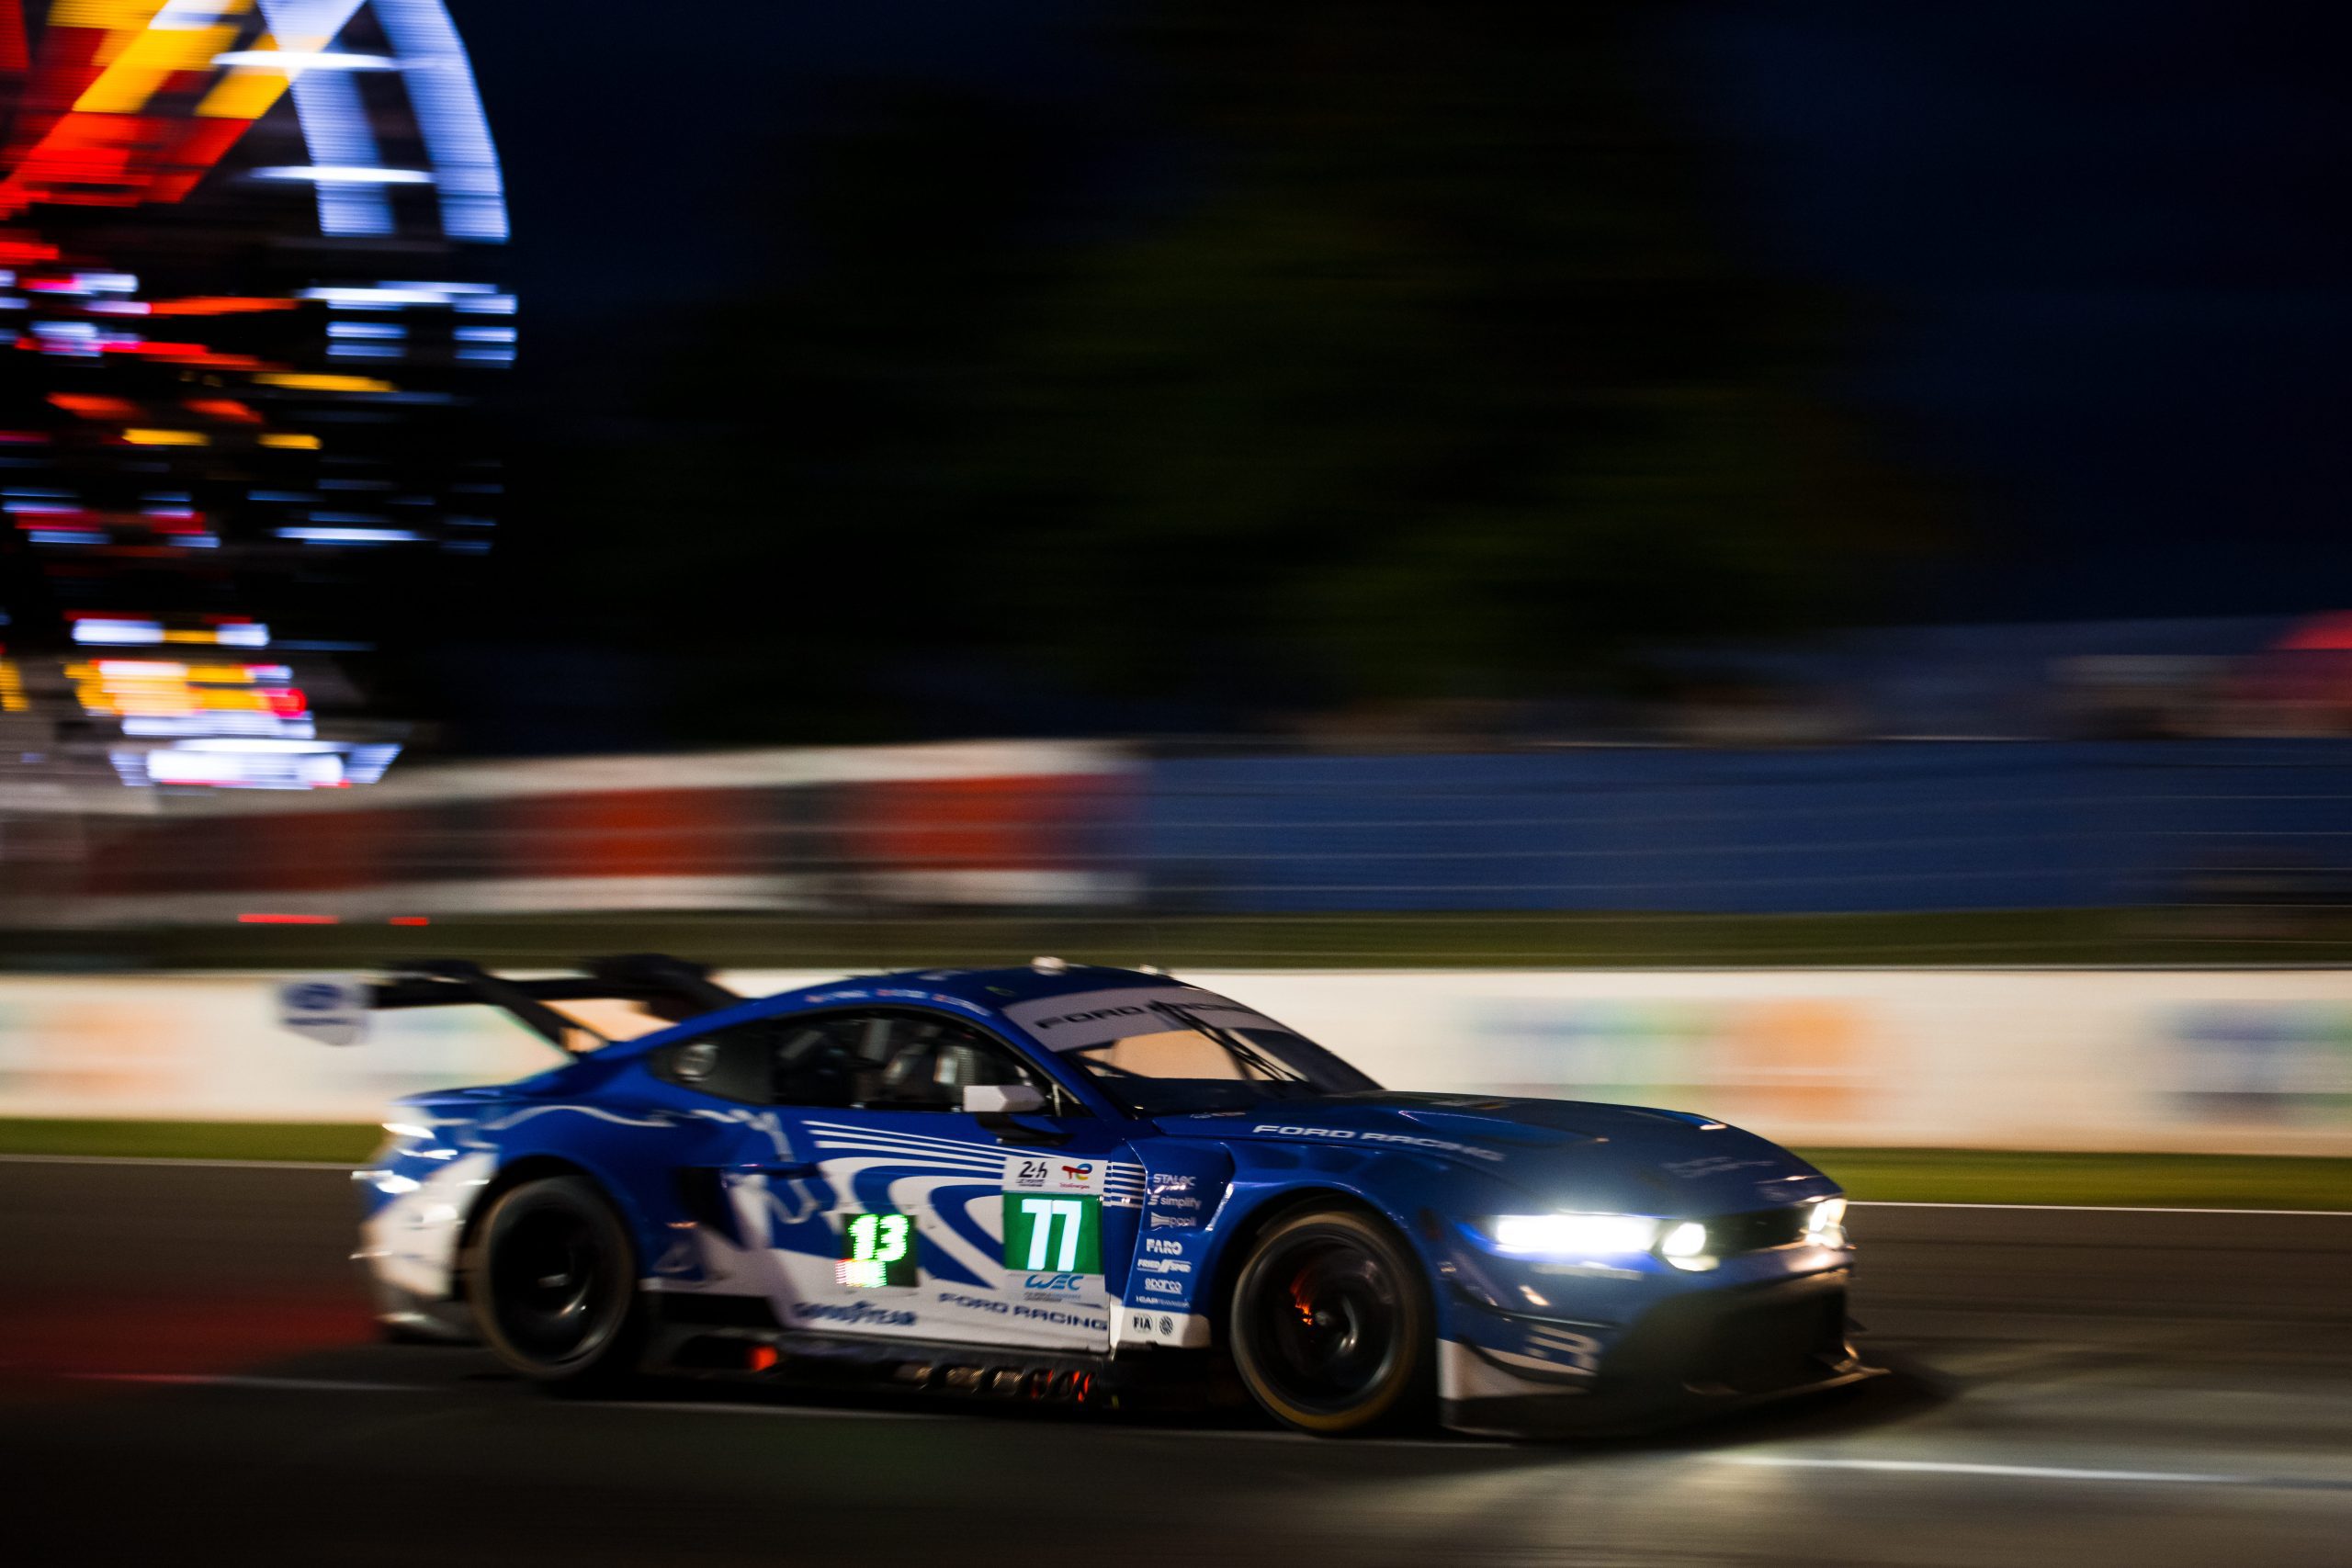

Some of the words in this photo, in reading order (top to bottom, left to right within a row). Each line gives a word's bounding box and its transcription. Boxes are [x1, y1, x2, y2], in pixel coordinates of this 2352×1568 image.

[1034, 1005, 1147, 1030] FORD
[1252, 1124, 1357, 1140] FORD
[1360, 1132, 1506, 1162] RACING
[847, 1213, 910, 1263] 13
[1022, 1199, 1082, 1273] 77
[1146, 1238, 1183, 1256] FARO
[1024, 1273, 1084, 1292] WEC
[937, 1292, 1008, 1315] FORD
[1013, 1305, 1108, 1332] RACING
[1133, 1315, 1152, 1331] FIA
